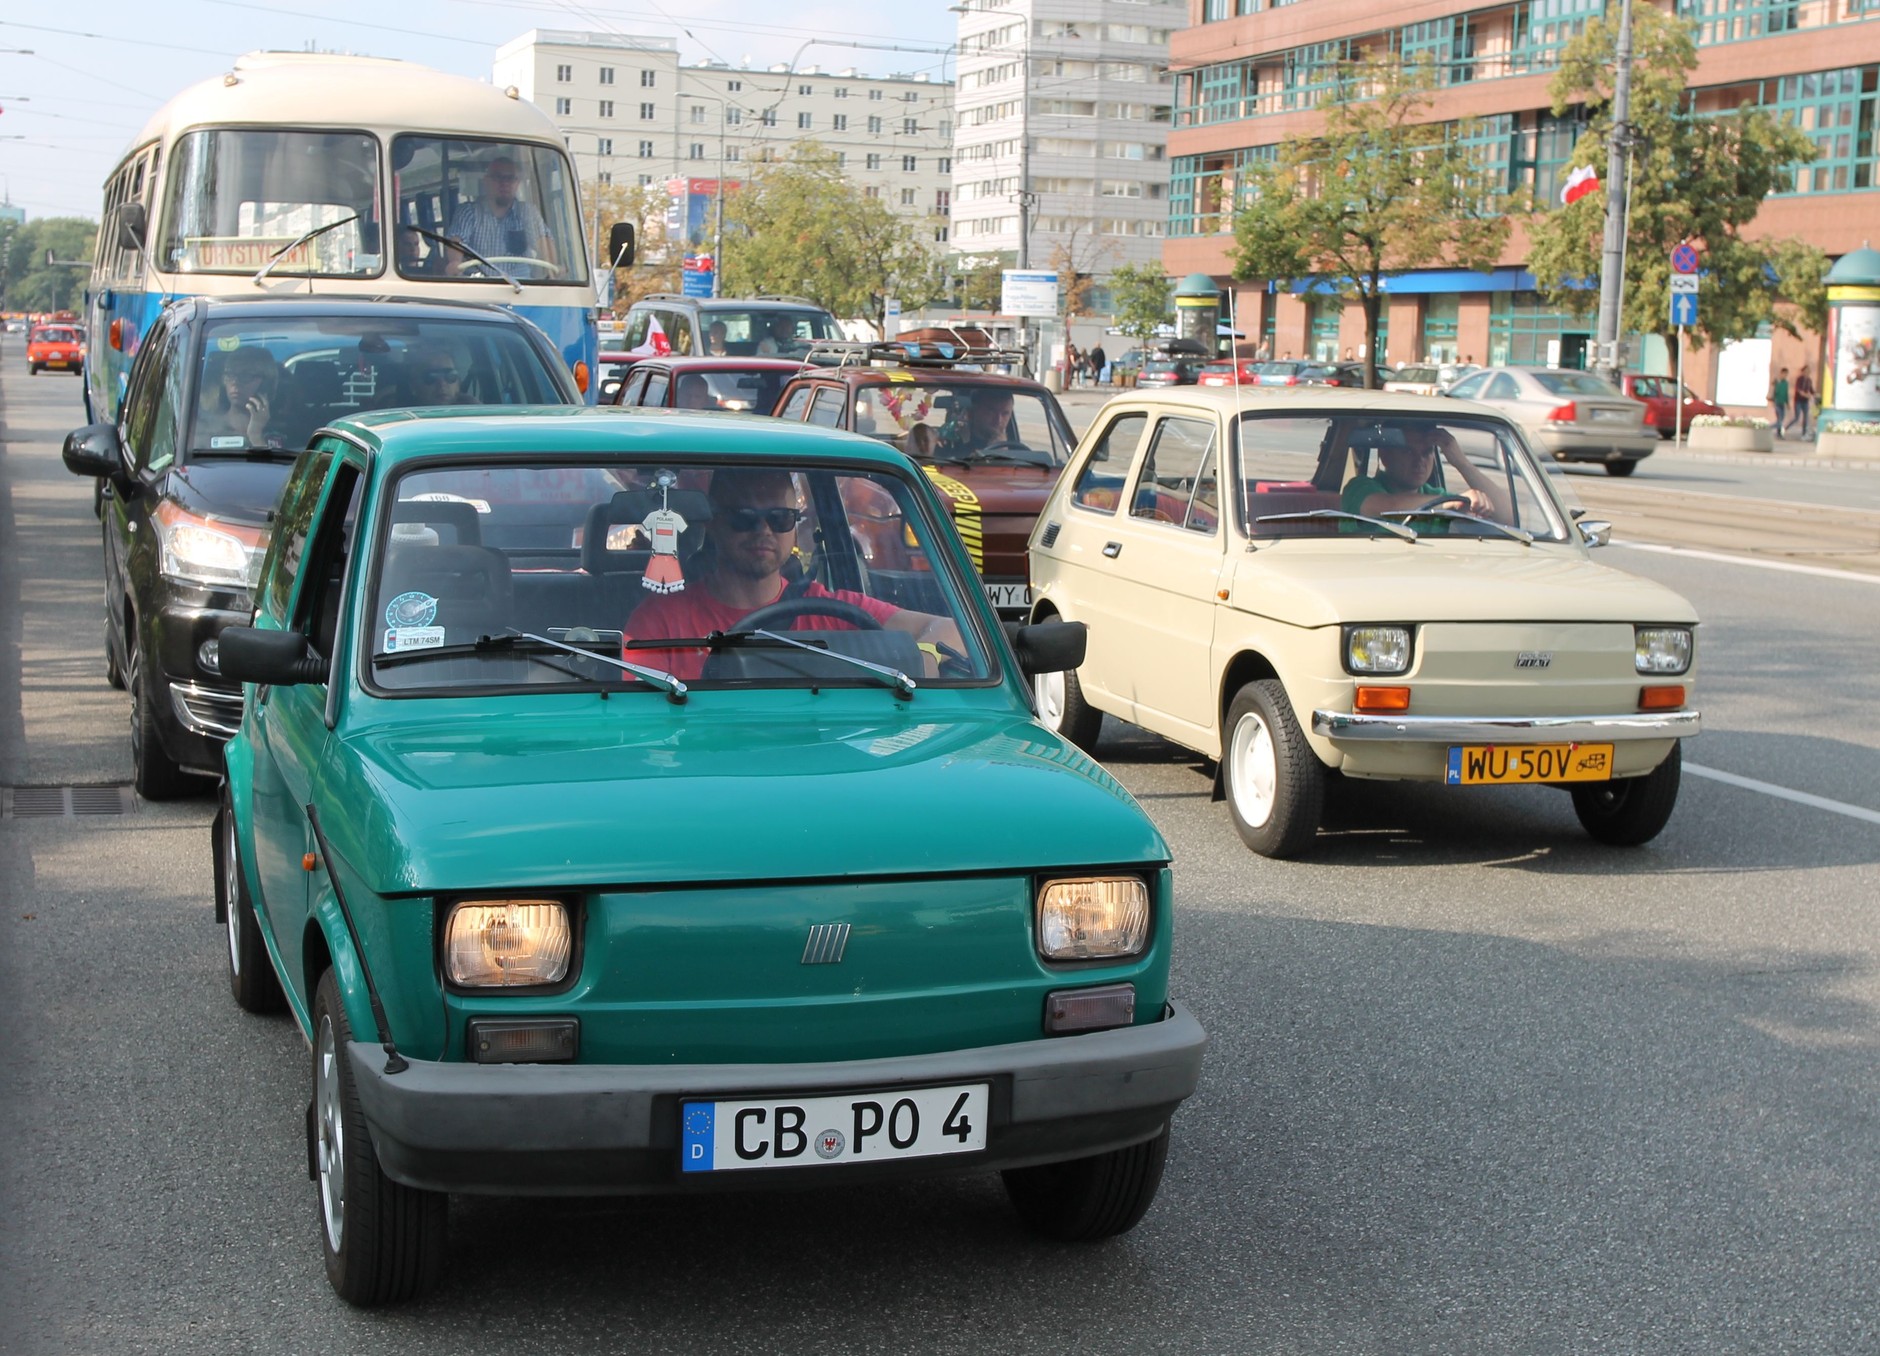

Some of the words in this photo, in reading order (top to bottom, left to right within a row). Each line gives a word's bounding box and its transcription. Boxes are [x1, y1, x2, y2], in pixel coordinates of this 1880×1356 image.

[988, 586, 1016, 605] WY
[404, 637, 420, 646] LTM
[421, 635, 441, 645] 74SM
[1517, 659, 1551, 667] FIAT
[1468, 749, 1509, 780] WU
[1519, 748, 1573, 779] 50V
[1449, 769, 1460, 778] PL
[734, 1105, 808, 1161] CB
[851, 1097, 920, 1154] PO
[942, 1091, 972, 1144] 4
[691, 1143, 704, 1160] D
